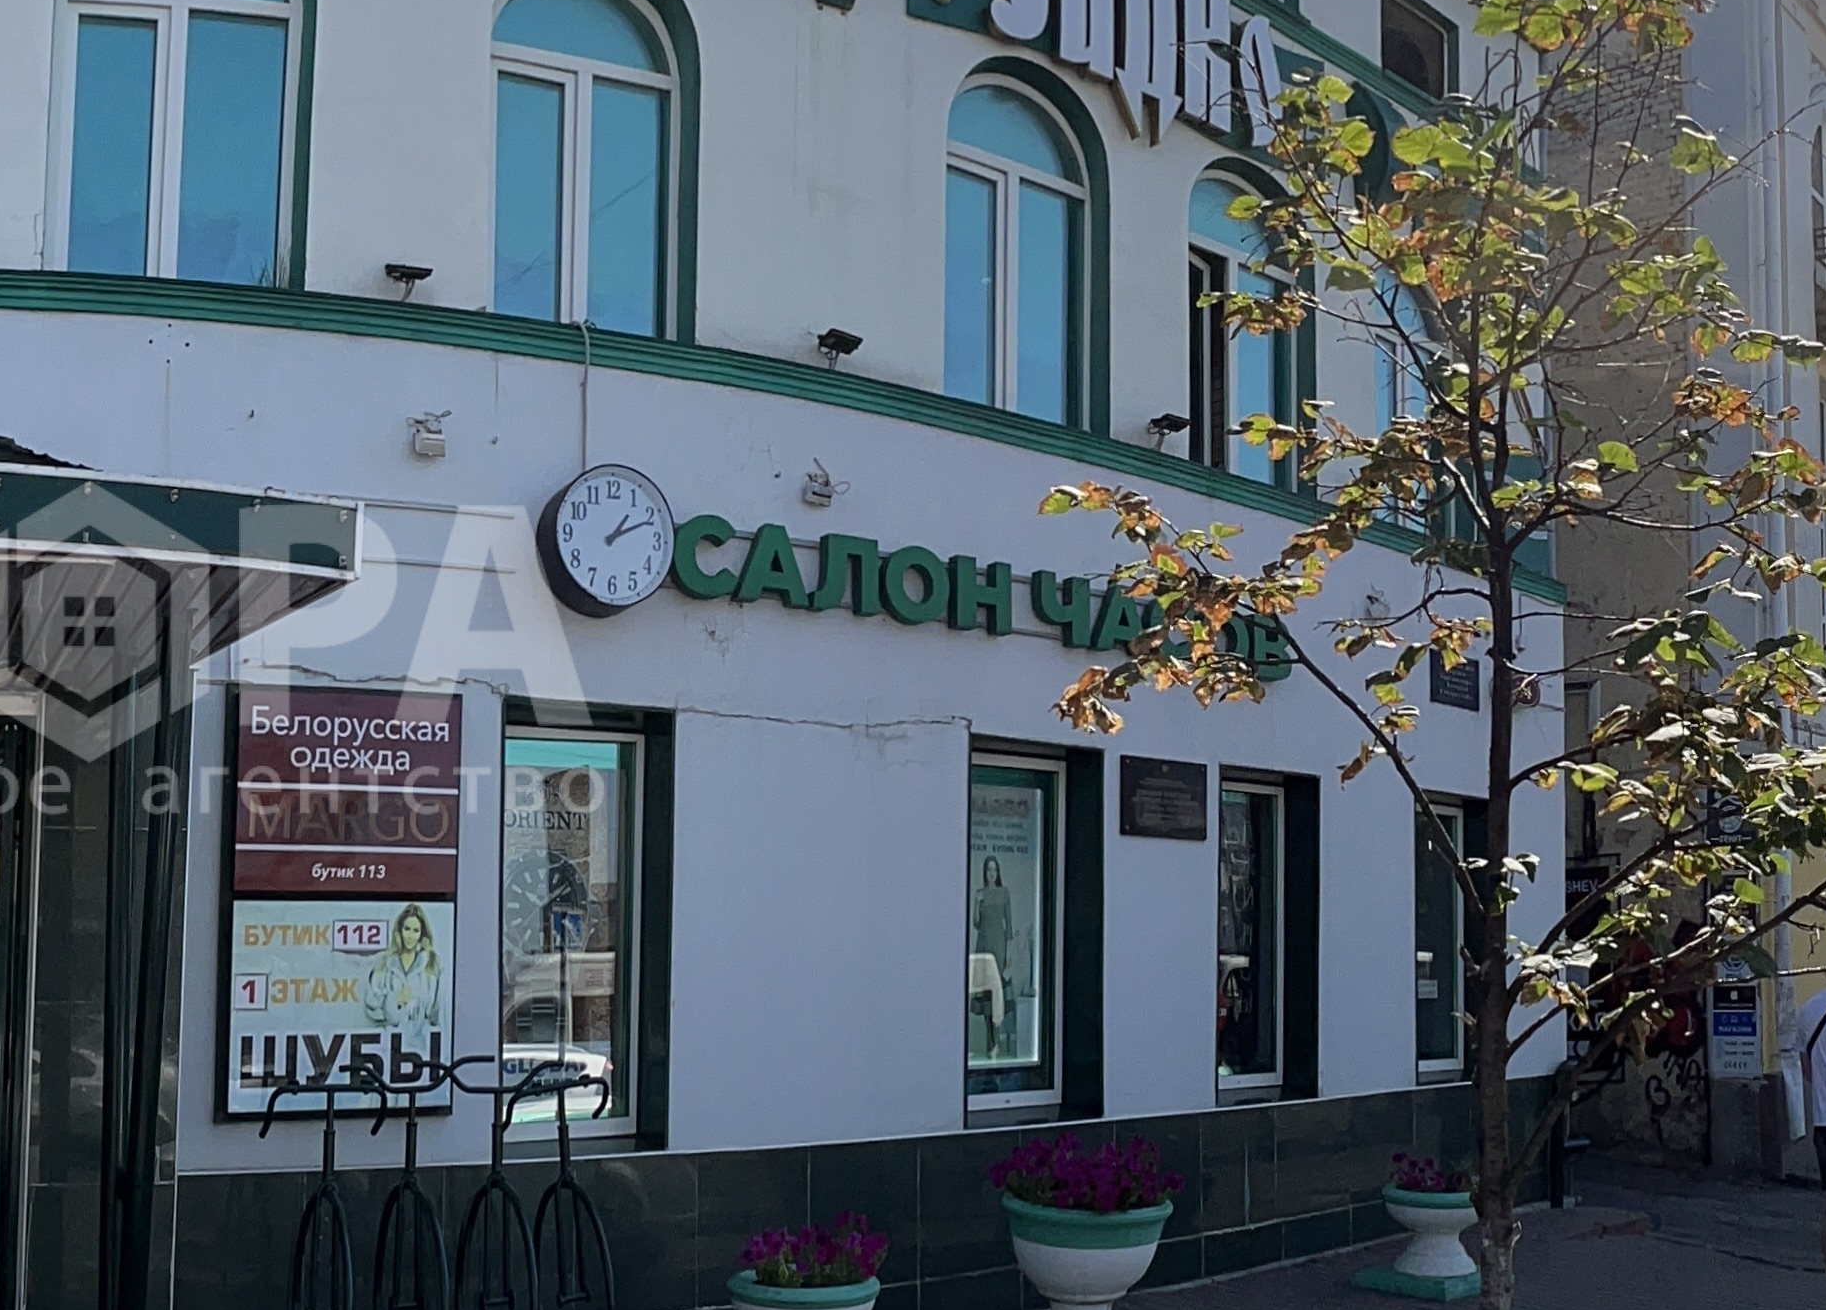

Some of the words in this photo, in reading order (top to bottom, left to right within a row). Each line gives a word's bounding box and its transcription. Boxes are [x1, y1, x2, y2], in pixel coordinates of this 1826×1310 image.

[586, 485, 601, 505] 11
[606, 480, 621, 500] 12
[630, 488, 638, 508] 1
[570, 501, 587, 520] 10
[645, 506, 655, 526] 2
[562, 523, 573, 543] 9
[652, 532, 662, 552] 3
[570, 548, 581, 569] 8
[642, 555, 652, 575] 4
[587, 567, 598, 588] 7
[607, 575, 618, 595] 6
[627, 571, 638, 591] 5
[670, 513, 1013, 637] САЛОН
[250, 705, 450, 746] Белорусская
[290, 746, 411, 776] одежда
[248, 792, 449, 843] MARGO
[503, 810, 587, 831] ORIENT
[311, 863, 354, 881] бутик
[358, 864, 386, 879] 113
[242, 923, 331, 948] БУТИК
[336, 924, 382, 947] 112
[240, 980, 257, 1005] 1
[270, 978, 358, 1005] ЭТАЖ
[238, 1031, 443, 1087] ШУБЫ
